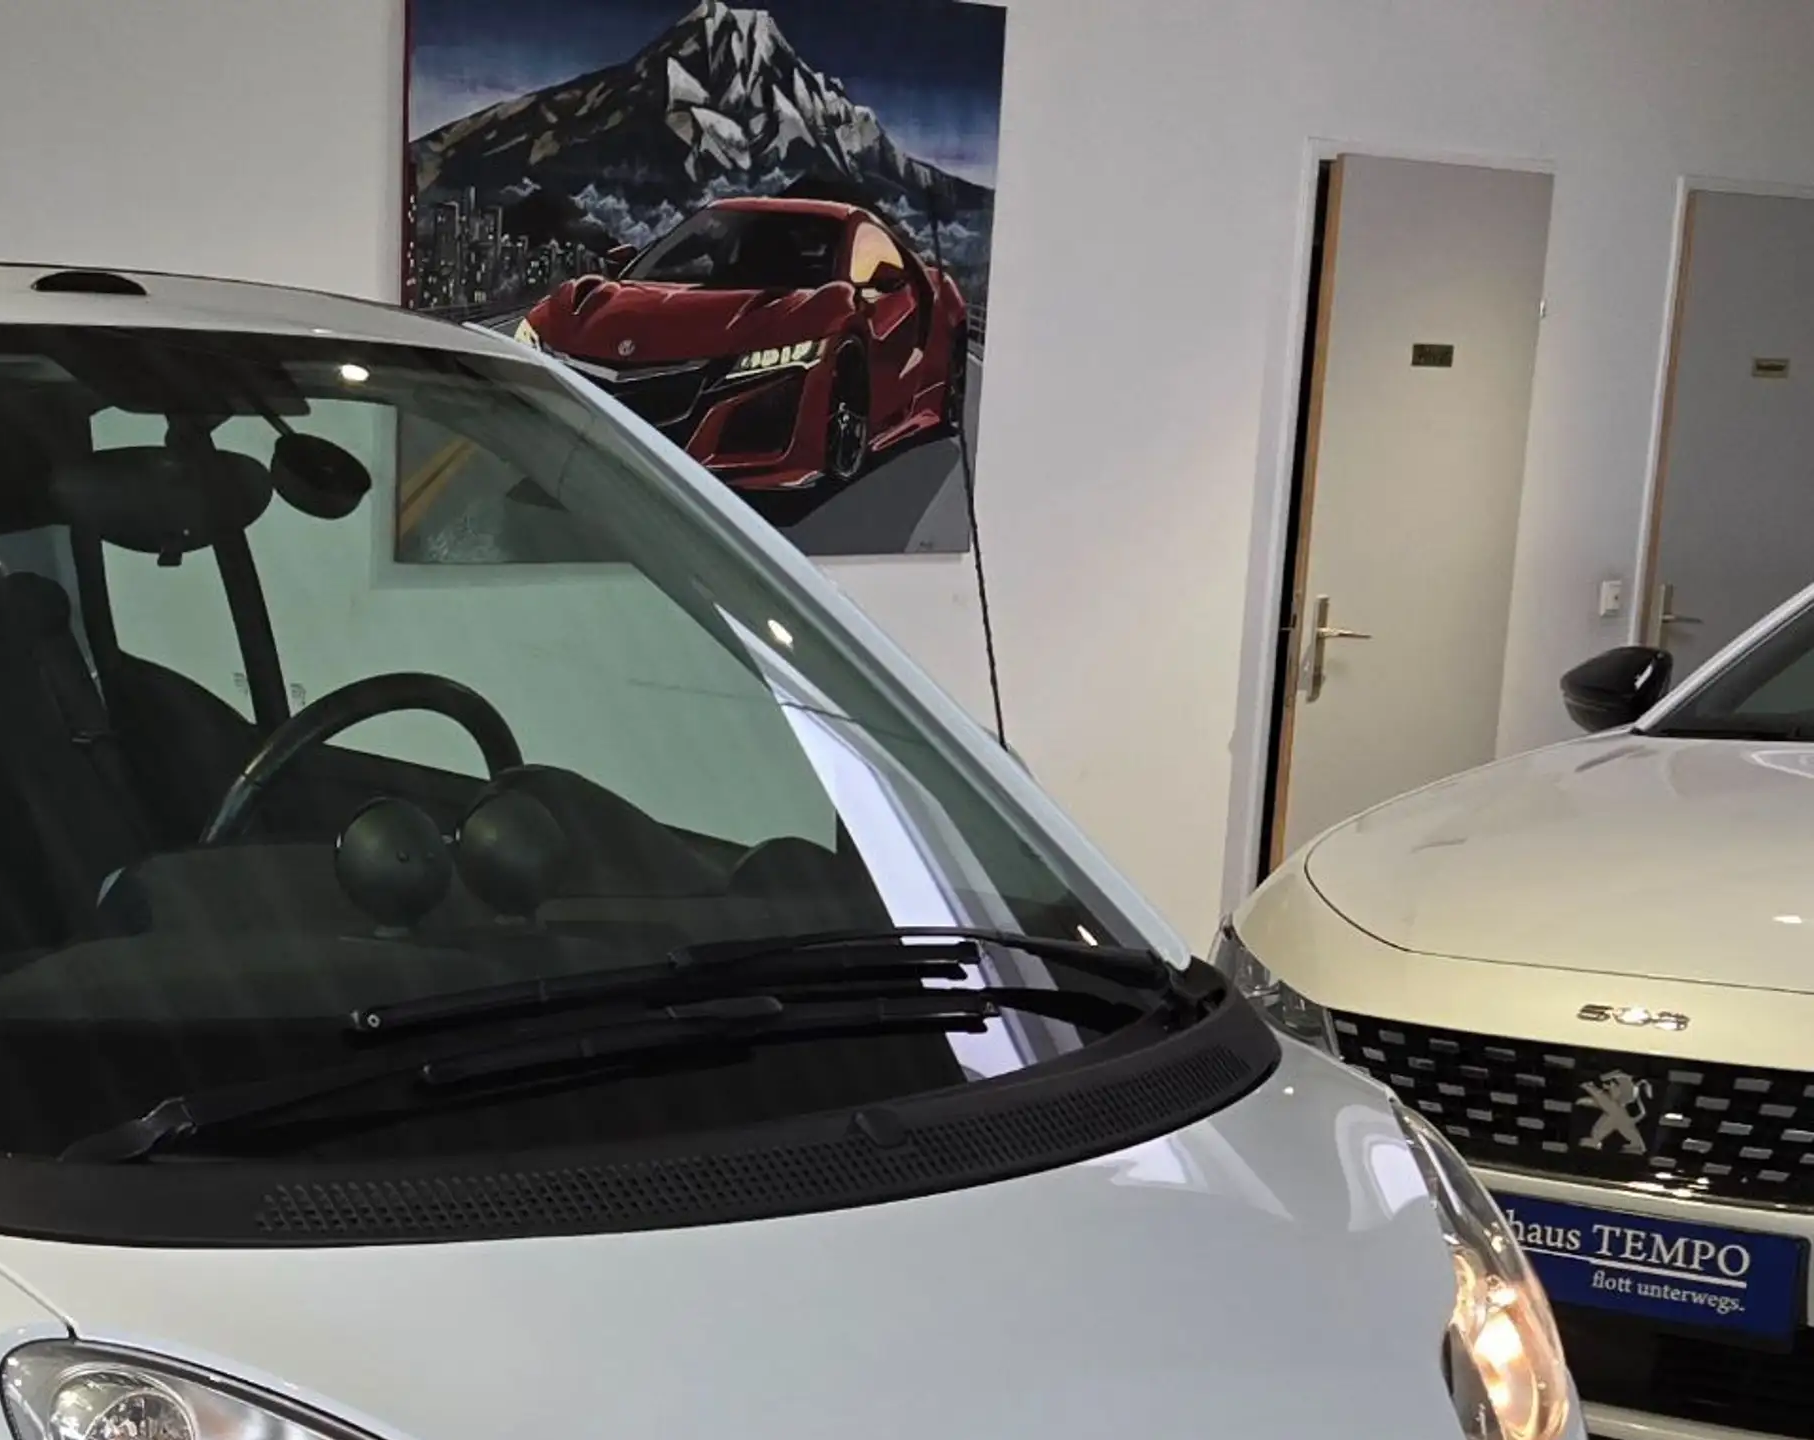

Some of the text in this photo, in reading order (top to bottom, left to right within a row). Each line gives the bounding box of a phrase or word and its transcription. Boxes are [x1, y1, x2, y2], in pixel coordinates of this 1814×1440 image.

[1592, 1224, 1751, 1277] TEMPO
[1591, 1270, 1746, 1315] flott unterwegs.
